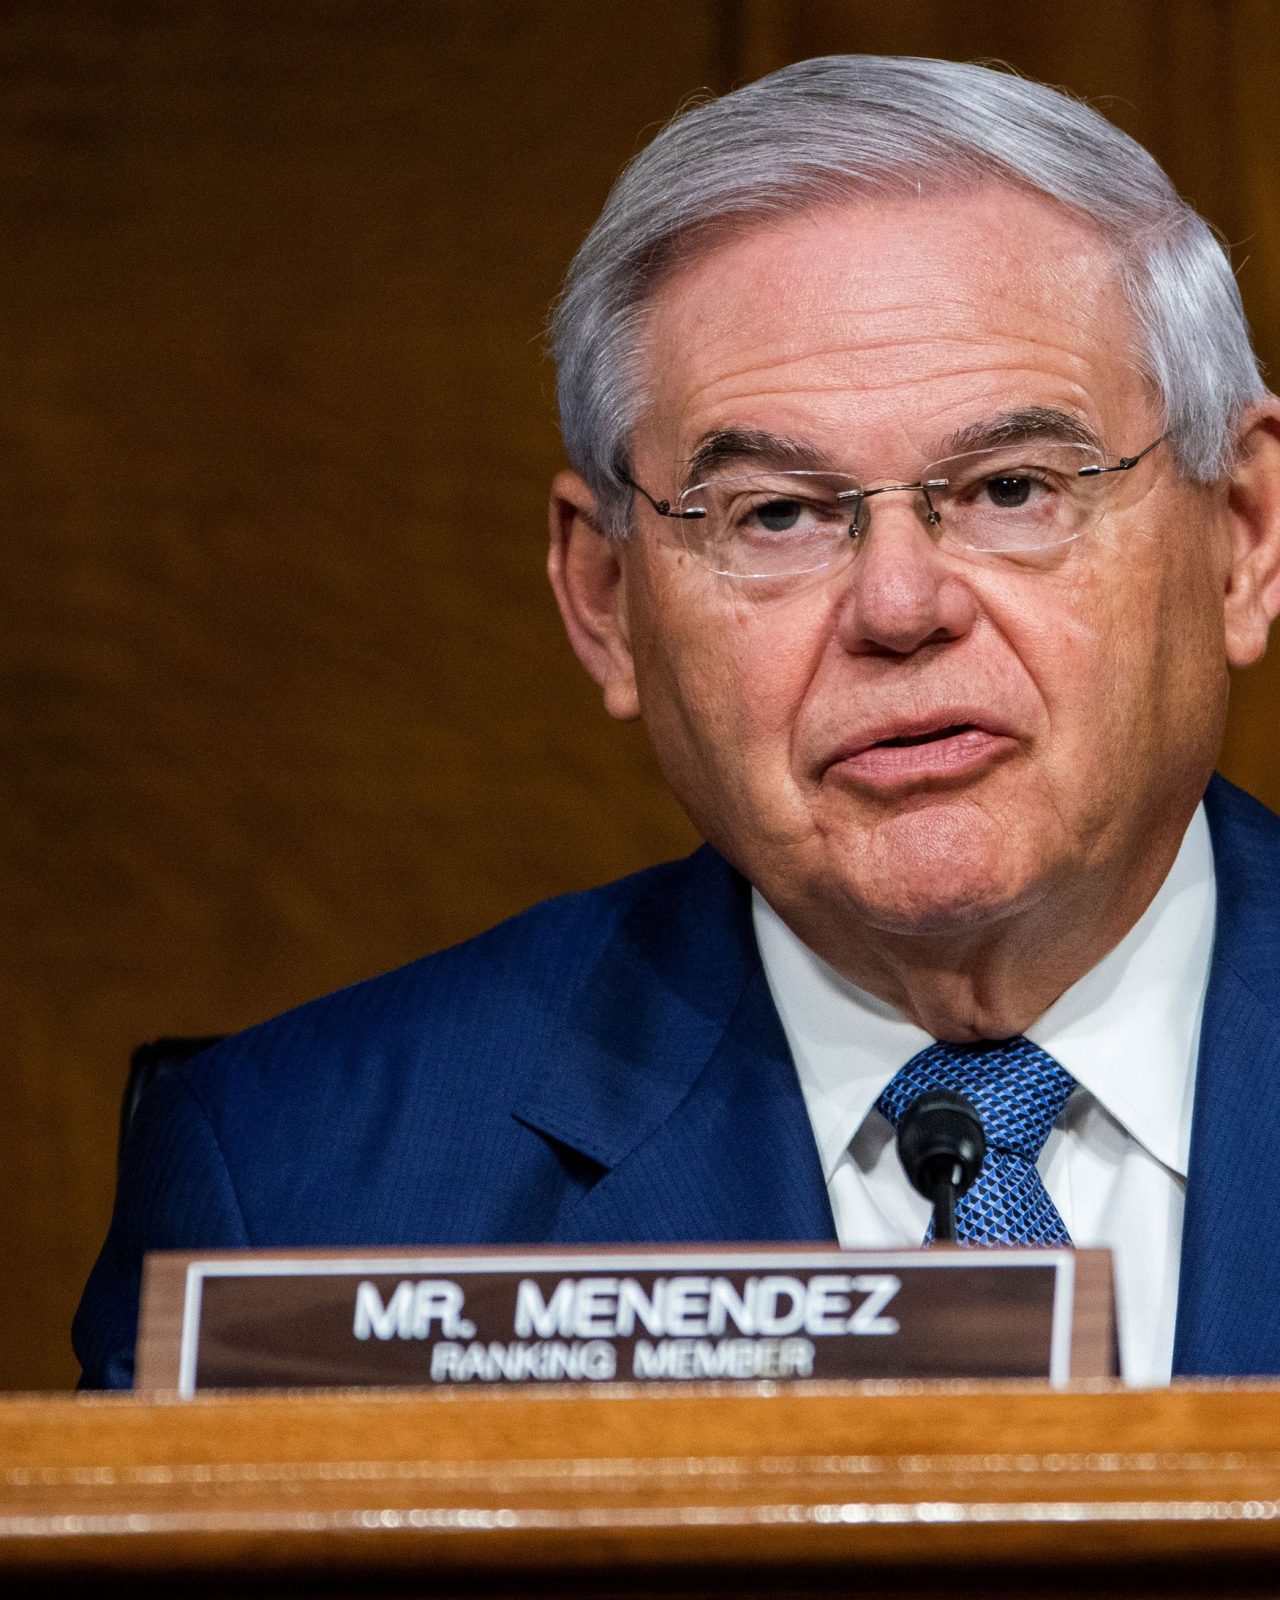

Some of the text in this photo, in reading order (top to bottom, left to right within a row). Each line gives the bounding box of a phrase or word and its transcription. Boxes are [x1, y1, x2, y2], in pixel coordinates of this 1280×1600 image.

[353, 1275, 900, 1340] MR. MENENDEZ
[430, 1338, 815, 1381] RANKING MEMBER
